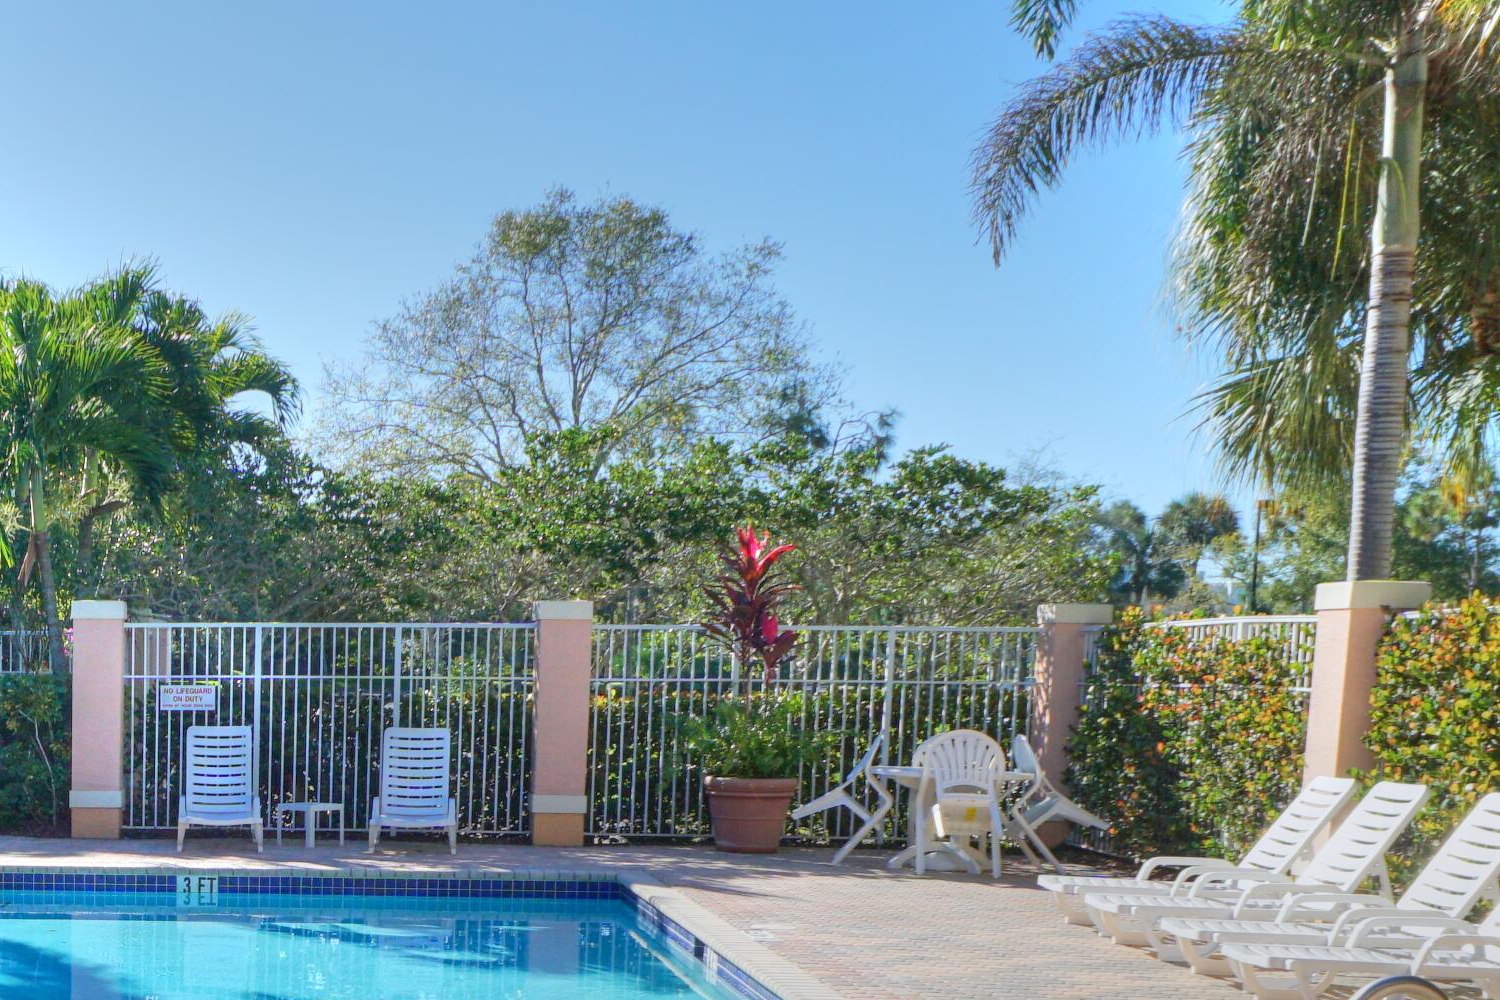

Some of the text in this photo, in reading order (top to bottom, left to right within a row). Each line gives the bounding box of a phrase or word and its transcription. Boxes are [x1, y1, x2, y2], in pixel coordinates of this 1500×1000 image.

[176, 687, 213, 695] LIFEGUARD
[173, 695, 204, 703] ON DUTY
[183, 876, 217, 894] 3 FT
